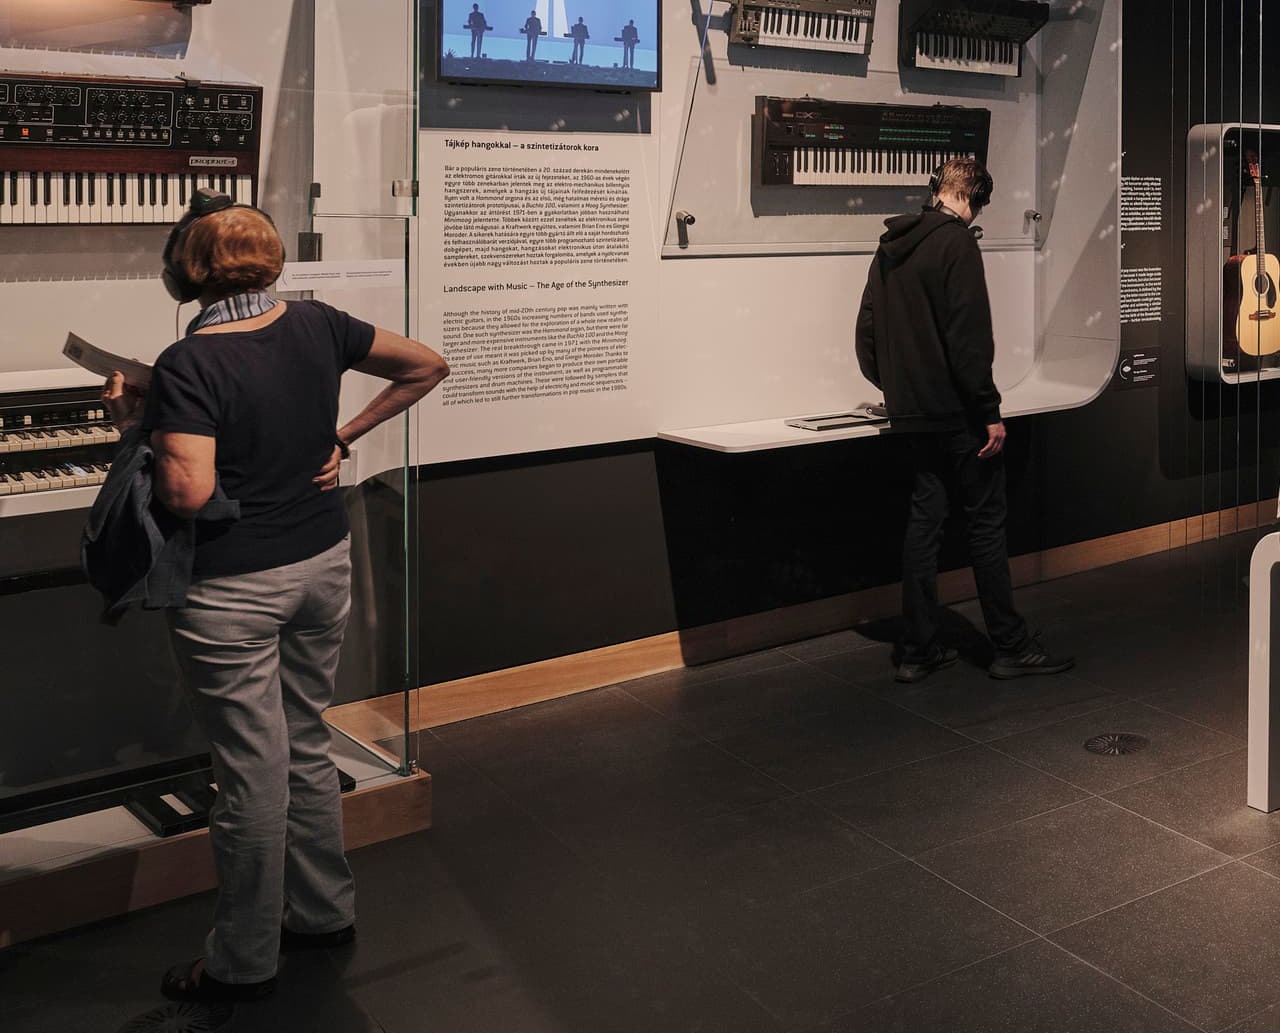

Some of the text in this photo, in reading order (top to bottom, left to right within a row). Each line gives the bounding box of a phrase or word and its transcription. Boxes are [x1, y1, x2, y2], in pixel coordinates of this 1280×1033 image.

[444, 139, 470, 149] Tájkép
[471, 140, 512, 150] hangokkal
[526, 142, 582, 151] szintetizátorok
[443, 284, 486, 293] Landscape
[488, 282, 505, 291] with
[506, 281, 528, 290] Music
[537, 281, 550, 289] The
[551, 281, 565, 290] Age
[566, 280, 574, 288] of
[588, 279, 629, 289] Synthesizer
